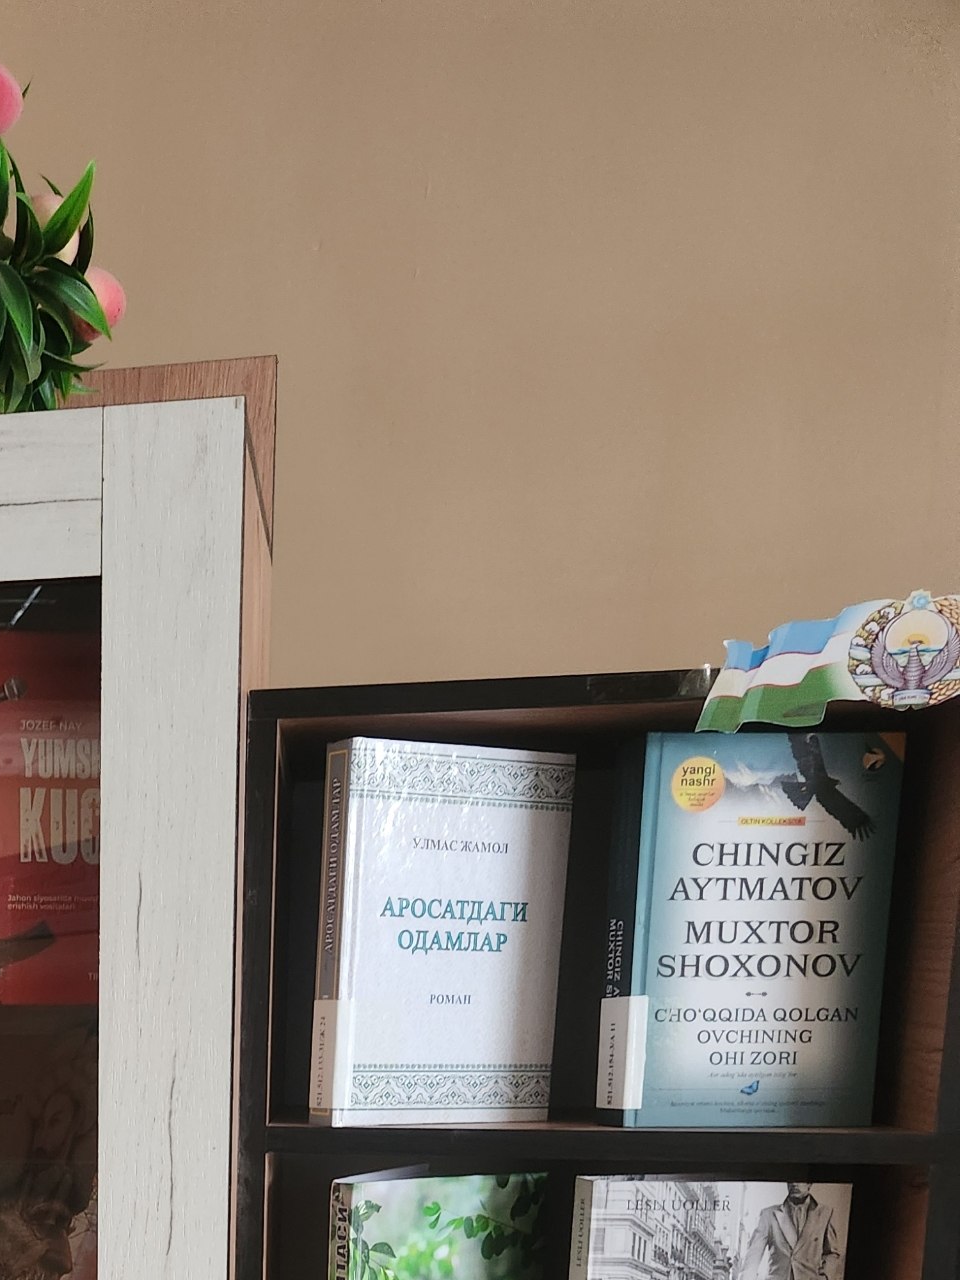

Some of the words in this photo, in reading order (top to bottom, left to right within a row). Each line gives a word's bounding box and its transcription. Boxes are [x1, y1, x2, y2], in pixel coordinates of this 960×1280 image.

[20, 719, 55, 731] JOZEF
[59, 719, 82, 731] NAY
[680, 774, 716, 787] nashr
[682, 763, 716, 777] yangi
[460, 840, 509, 854] ЖАМОЛ
[692, 842, 847, 867] CHINGIZ
[667, 876, 864, 901] AYTMATOV
[324, 857, 338, 953] АРОСАТДАГИ
[380, 896, 529, 925] АРОСАТДАГИ
[398, 929, 508, 955] ОДАМЛАР
[684, 920, 840, 945] MUXTOR
[606, 919, 617, 980] MUXTOR
[614, 920, 624, 982] CHINGIZ
[656, 953, 864, 978] SHOXONOV
[429, 993, 472, 1005] РОМАН
[773, 1006, 859, 1022] QOLGAN
[697, 1029, 813, 1044] OVCHINING
[709, 1051, 744, 1066] OHI
[750, 1051, 797, 1066] ZORI
